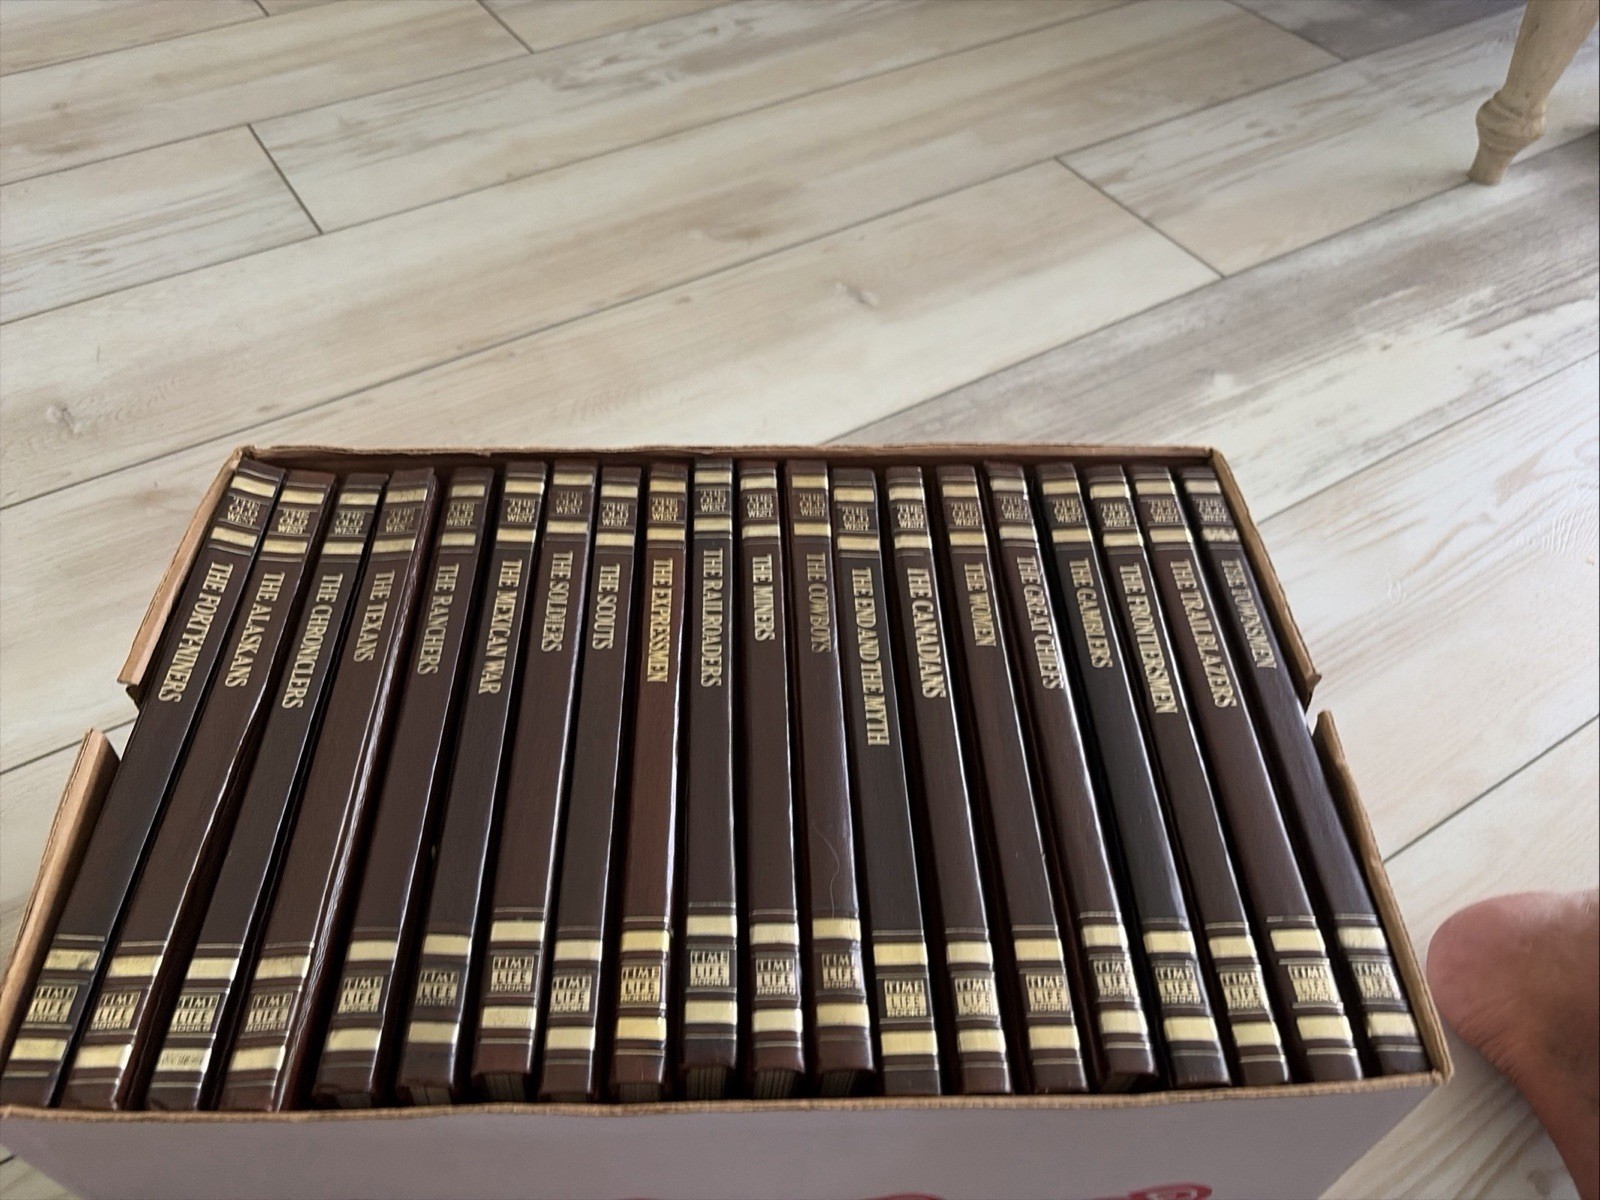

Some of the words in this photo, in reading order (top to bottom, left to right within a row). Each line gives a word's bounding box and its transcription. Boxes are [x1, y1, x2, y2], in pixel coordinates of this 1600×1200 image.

[227, 512, 257, 526] WEST
[507, 514, 534, 523] WEST
[652, 513, 678, 522] WEST
[701, 504, 727, 512] WEST
[748, 510, 774, 518] WEST
[954, 518, 980, 526] WEST
[277, 524, 306, 534] WEST
[334, 525, 362, 535] WEST
[446, 519, 472, 527] WEST
[602, 518, 628, 527] WEST
[844, 522, 870, 531] WEST
[900, 520, 924, 528] WEST
[1104, 518, 1131, 527] WEST
[202, 562, 233, 593] THE
[435, 563, 459, 592] THE
[498, 559, 523, 588] THE
[551, 551, 573, 580] THE
[599, 563, 620, 593] THE
[653, 558, 673, 587] THE
[703, 548, 723, 580] THE
[752, 554, 773, 583] THE
[807, 553, 826, 581] THE
[965, 562, 987, 592] THE
[1017, 556, 1041, 584] THE
[1069, 558, 1094, 587] THE
[1170, 559, 1197, 590] THE
[256, 572, 285, 601] THE
[316, 573, 344, 602] THE
[370, 570, 395, 600] THE
[852, 567, 873, 597] THE
[907, 567, 933, 598] THE
[1119, 563, 1146, 594] THE
[486, 590, 517, 657] MEXICAN
[541, 580, 569, 652] SOLDIERS
[592, 594, 616, 649] SCOUTS
[753, 585, 775, 641] MINERS
[808, 583, 831, 653] COWBOYS
[855, 597, 877, 628] END
[969, 593, 996, 646] WOMEN
[1023, 585, 1052, 634] GREAT
[354, 602, 387, 662] TEXANS
[417, 594, 452, 675] RANCHERS
[647, 588, 672, 682] EXPRESSMEN
[701, 580, 723, 687] RAILROADERS
[1076, 588, 1113, 668] GAMBLERS
[225, 603, 272, 687] ALASKANS
[282, 605, 333, 708] CHRONICLERS
[857, 627, 880, 663] AND
[912, 600, 946, 698] CANADIANS
[1127, 595, 1178, 714] FRONTIERSMEN
[1180, 591, 1237, 708] TRAILBLAZERS
[478, 658, 505, 694] WAR
[1034, 634, 1064, 690] CHIEFS
[860, 662, 884, 696] THE
[864, 695, 890, 745] MYTH
[495, 957, 533, 969] TIME
[693, 952, 728, 965] TIME
[694, 966, 726, 979] LIFE
[758, 960, 792, 971] TIME
[1096, 962, 1130, 973] TIME
[345, 977, 383, 989] TIME
[422, 971, 458, 983] TIME
[495, 970, 529, 983] LIFE
[555, 976, 590, 988] TIME
[624, 967, 660, 979] TIME
[759, 972, 792, 986] LIFE
[826, 967, 857, 981] LIFE
[886, 980, 923, 993] TIME
[957, 979, 990, 991] TIME
[1028, 975, 1062, 988] TIME
[1100, 974, 1131, 988] LIFE
[1157, 968, 1193, 980] TIME
[254, 994, 292, 1007] TIME
[343, 990, 377, 1004] LIFE
[420, 984, 454, 998] LIFE
[554, 989, 587, 1003] LIFE
[624, 981, 657, 994] LIFE
[888, 995, 923, 1007] LIFE
[960, 993, 992, 1006] LIFE
[1031, 990, 1064, 1002] LIFE
[1161, 981, 1195, 995] LIFE
[251, 1008, 287, 1022] LIFE
